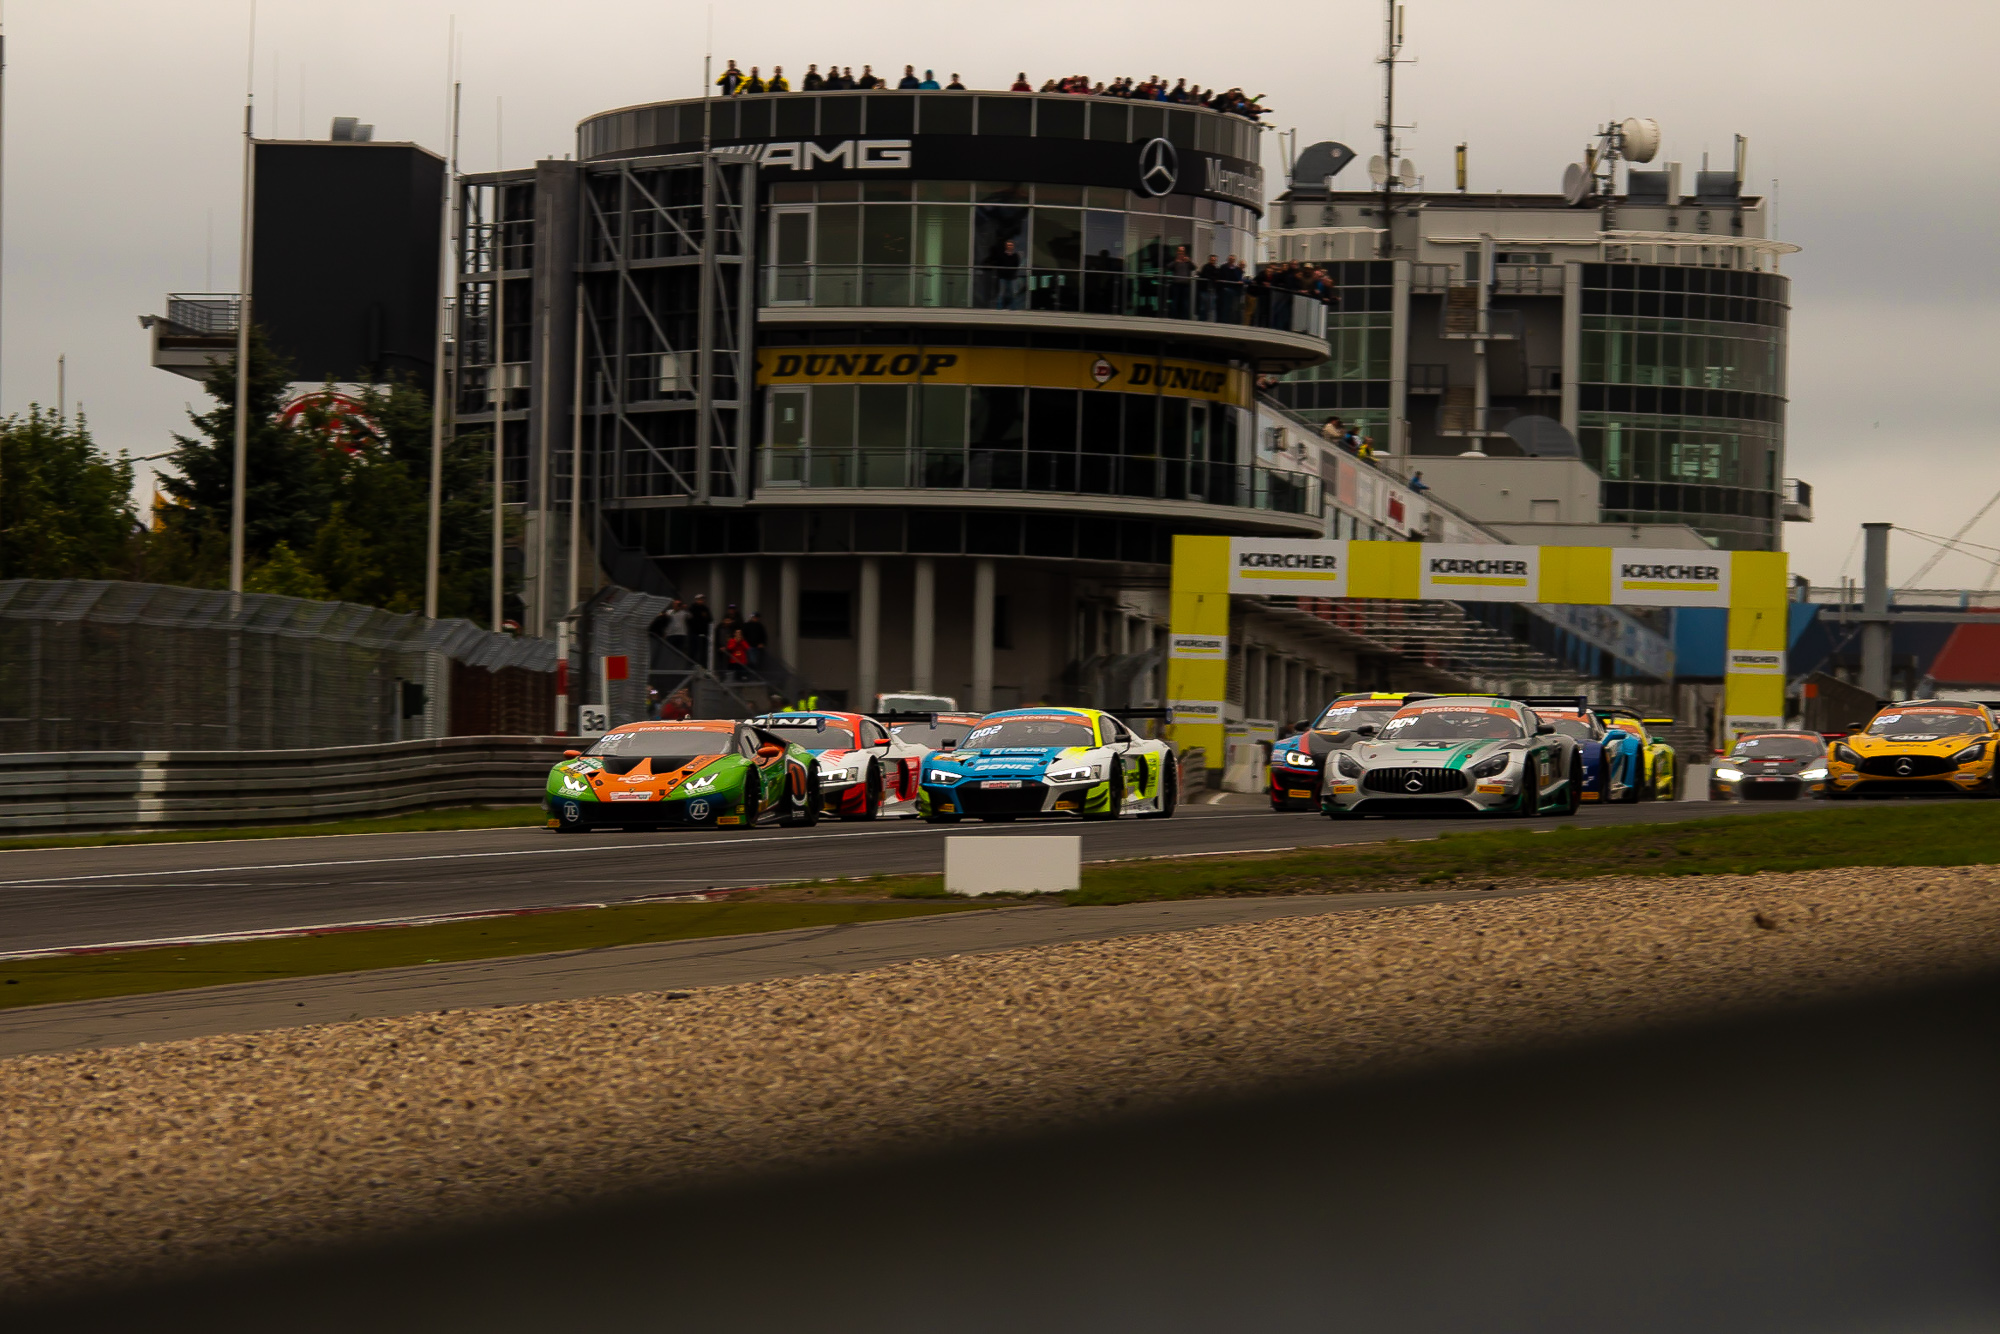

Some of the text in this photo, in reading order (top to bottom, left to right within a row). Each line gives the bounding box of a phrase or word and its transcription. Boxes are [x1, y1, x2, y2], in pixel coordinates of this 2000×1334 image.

[760, 139, 912, 171] AMG
[772, 354, 957, 377] DUNLOP
[1128, 363, 1226, 393] DUNLOP
[582, 709, 606, 731] 3a
[1421, 706, 1470, 714] postcon
[969, 725, 1004, 740] 002
[692, 804, 707, 815] ZF
